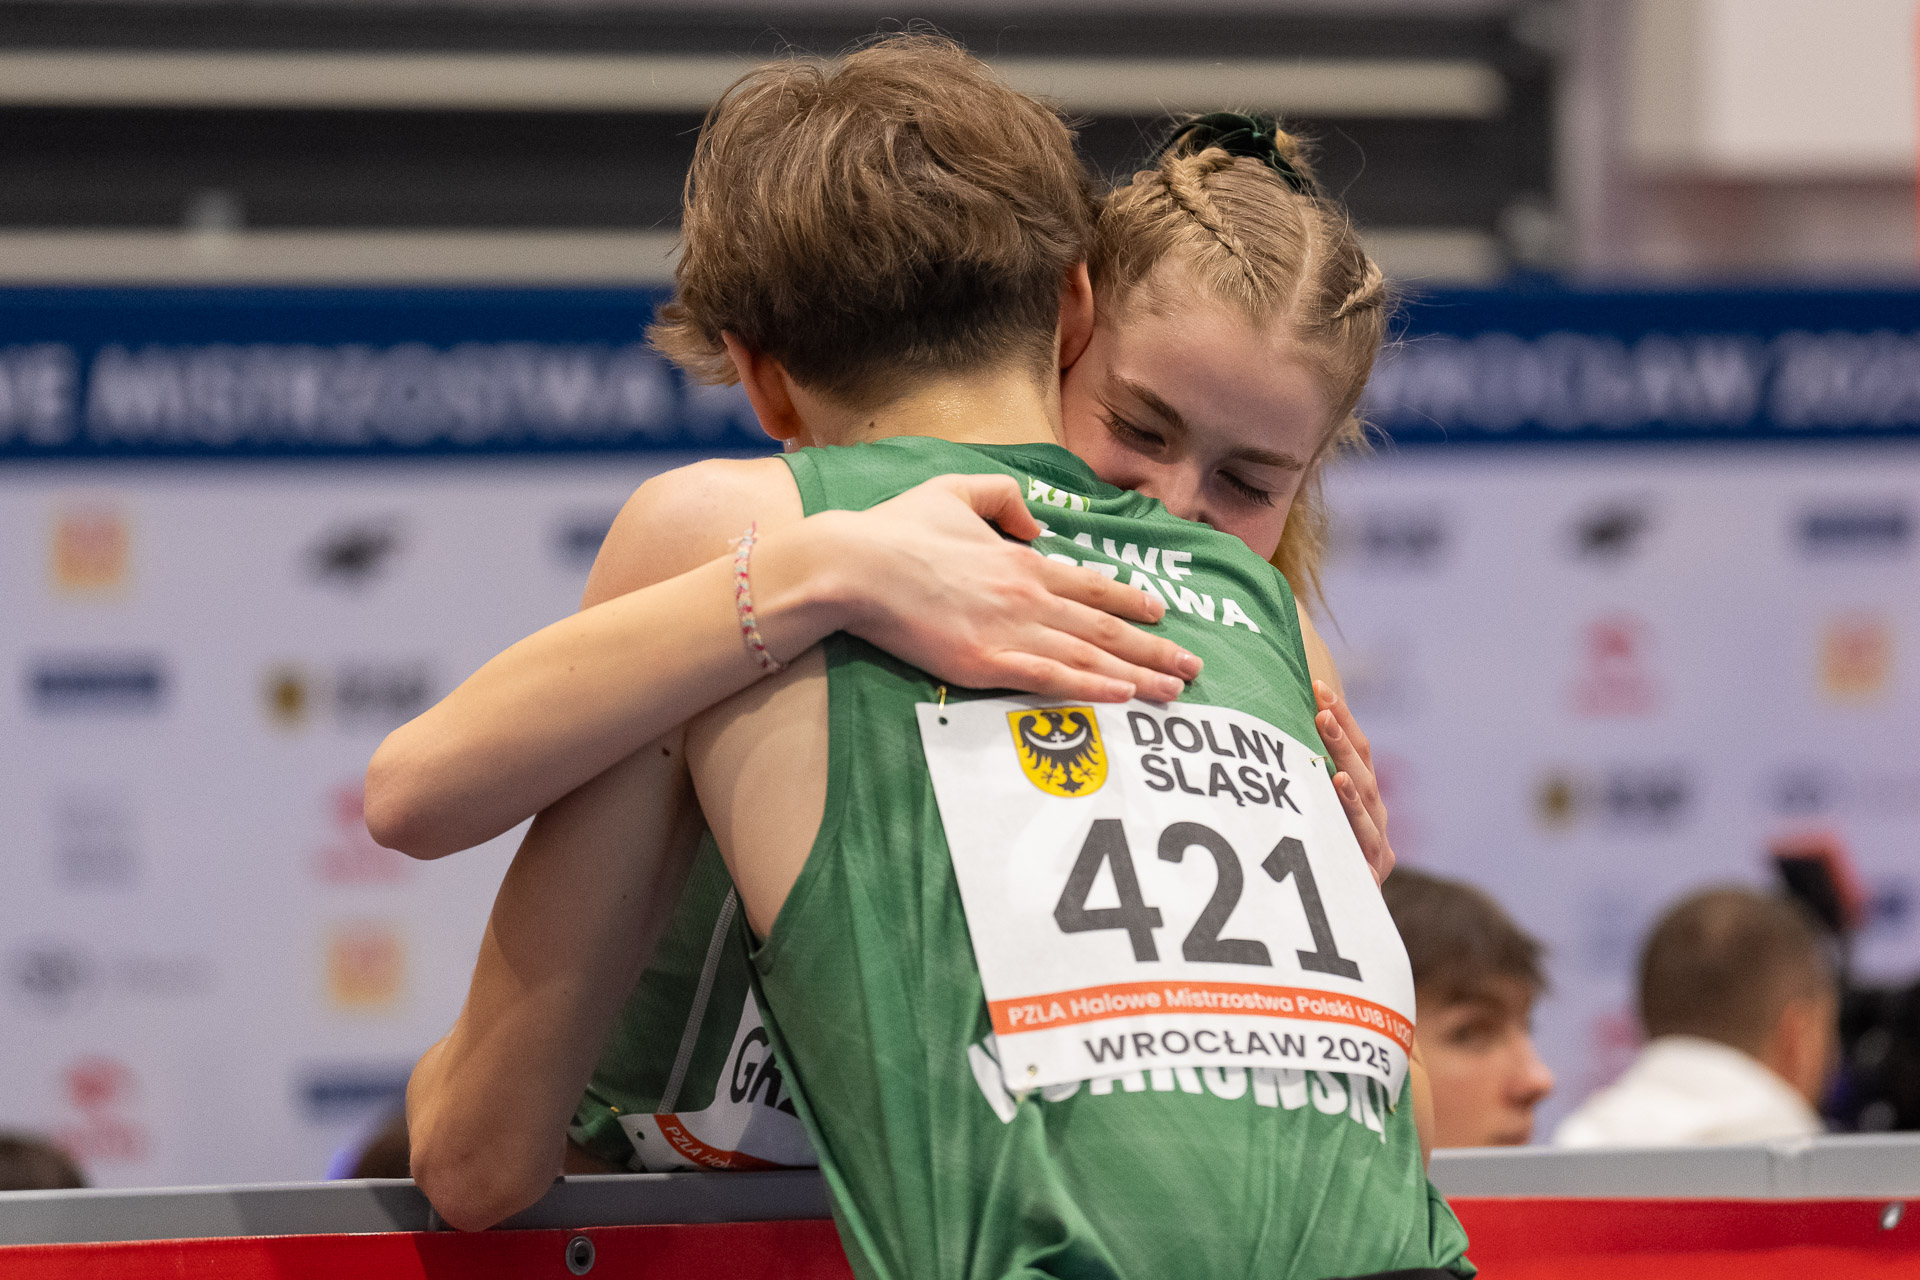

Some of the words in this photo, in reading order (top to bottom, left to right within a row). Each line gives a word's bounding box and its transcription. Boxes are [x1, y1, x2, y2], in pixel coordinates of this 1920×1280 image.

[1127, 711, 1287, 773] DOLNY
[1140, 747, 1303, 815] ŚLĄSK
[1053, 818, 1363, 982] 421
[1007, 1001, 1066, 1027] PZLA
[1069, 991, 1162, 1017] Halowe
[1164, 987, 1294, 1012] Mistrzostwa
[1296, 995, 1355, 1019] Polski
[1355, 1005, 1386, 1029] U18
[1385, 1013, 1393, 1033] i
[1084, 1030, 1306, 1064] WROCŁAW
[1317, 1035, 1391, 1076] 2025
[665, 1126, 703, 1157] PZLA
